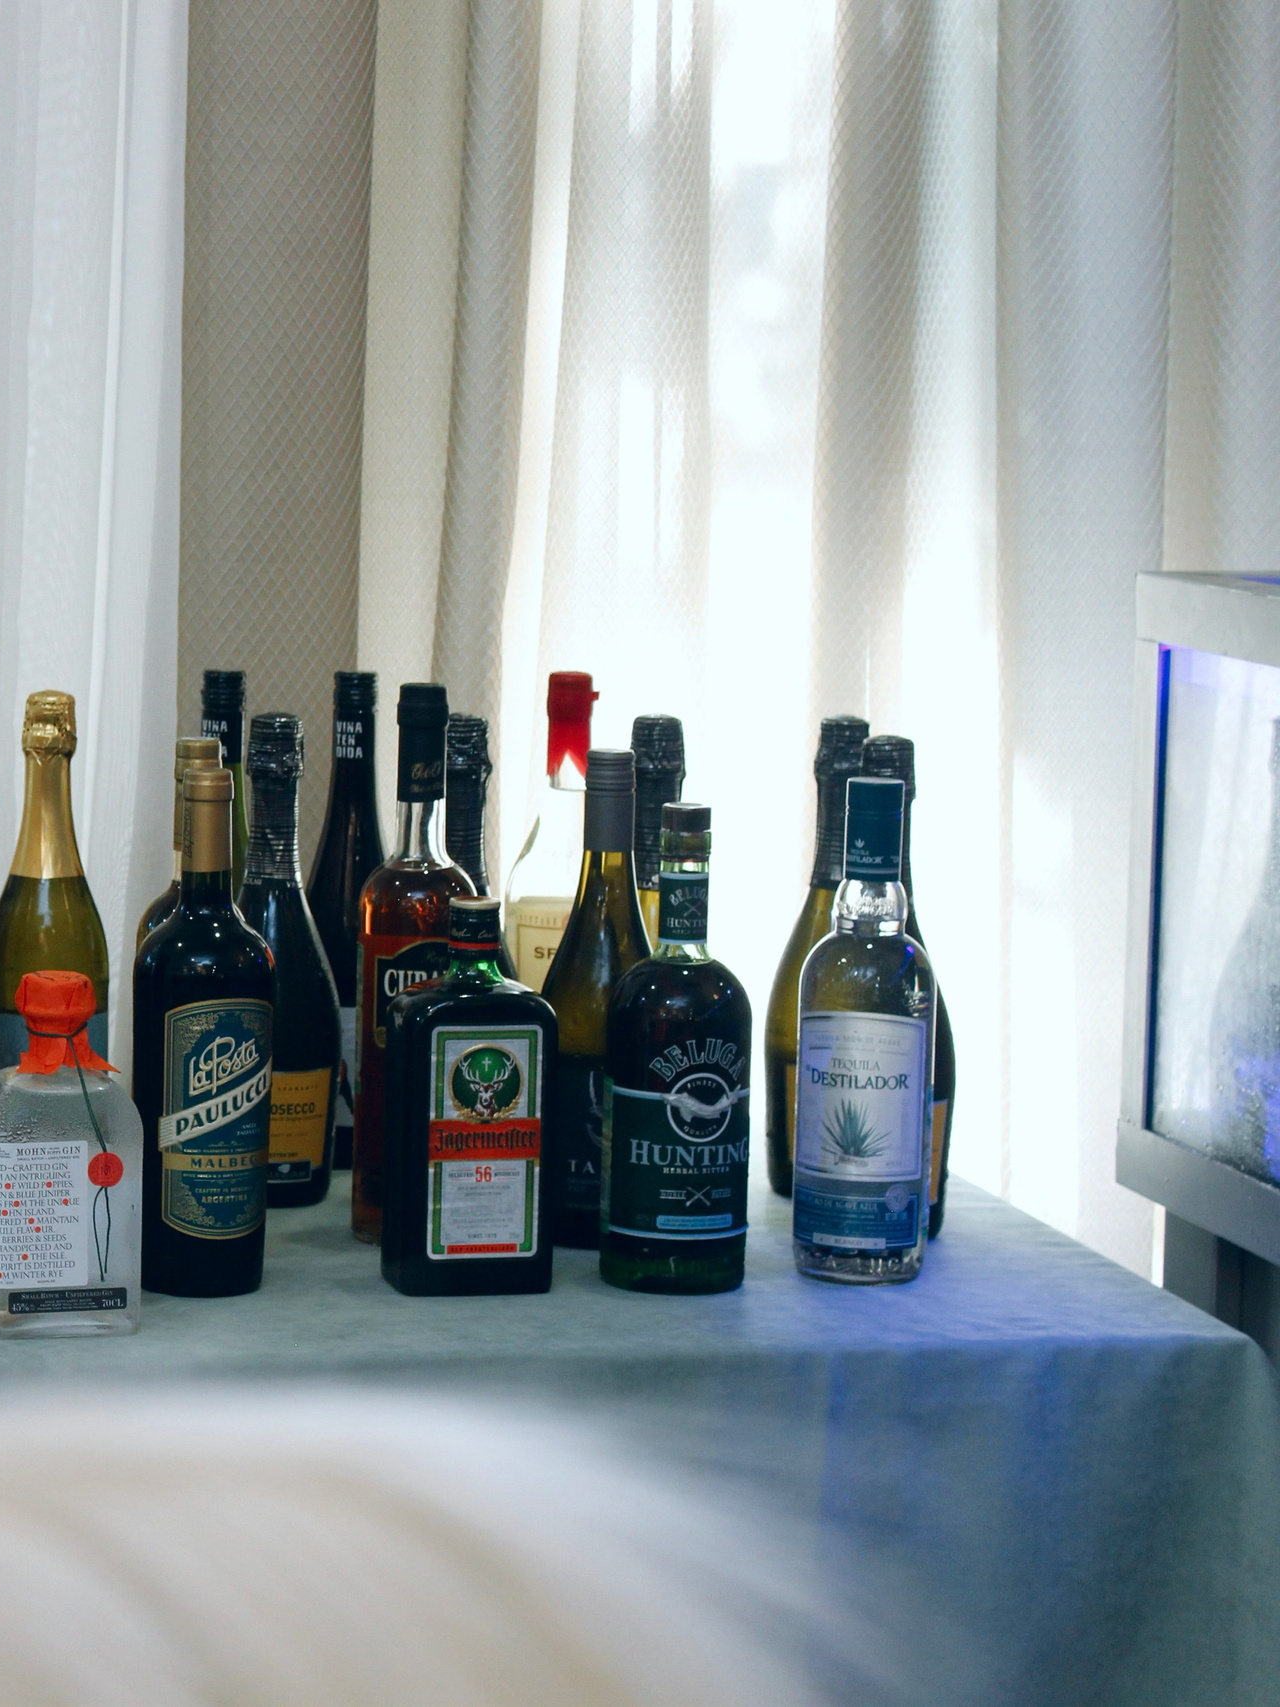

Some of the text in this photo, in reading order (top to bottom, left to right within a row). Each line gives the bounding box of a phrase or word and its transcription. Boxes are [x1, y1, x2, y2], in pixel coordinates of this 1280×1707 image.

[649, 1038, 746, 1082] BELUGA
[831, 1058, 881, 1071] TEQUILA
[175, 1071, 269, 1136] PAULUCCI
[684, 1124, 718, 1136] QUALITY
[16, 1147, 47, 1157] MOHN
[62, 1146, 81, 1155] GIN
[190, 1155, 256, 1169] MALBEC
[19, 1172, 71, 1180] INTRIGUING
[474, 1165, 493, 1183] 56
[663, 1167, 699, 1175] HERBAL
[38, 1190, 71, 1198] JUNIPER
[201, 1194, 248, 1204] ARGENTINA
[29, 1199, 46, 1207] THE
[36, 1216, 79, 1224] MAINTAIN
[2, 1235, 34, 1244] BERRIES
[43, 1234, 67, 1242] SEEDS
[53, 1243, 73, 1251] AND
[30, 1252, 47, 1260] THE
[49, 1252, 67, 1260] ISLE.
[24, 1262, 32, 1270] IS
[33, 1260, 76, 1269] DISTILLED
[11, 1271, 46, 1279] WINTER
[48, 1269, 64, 1278] RYE
